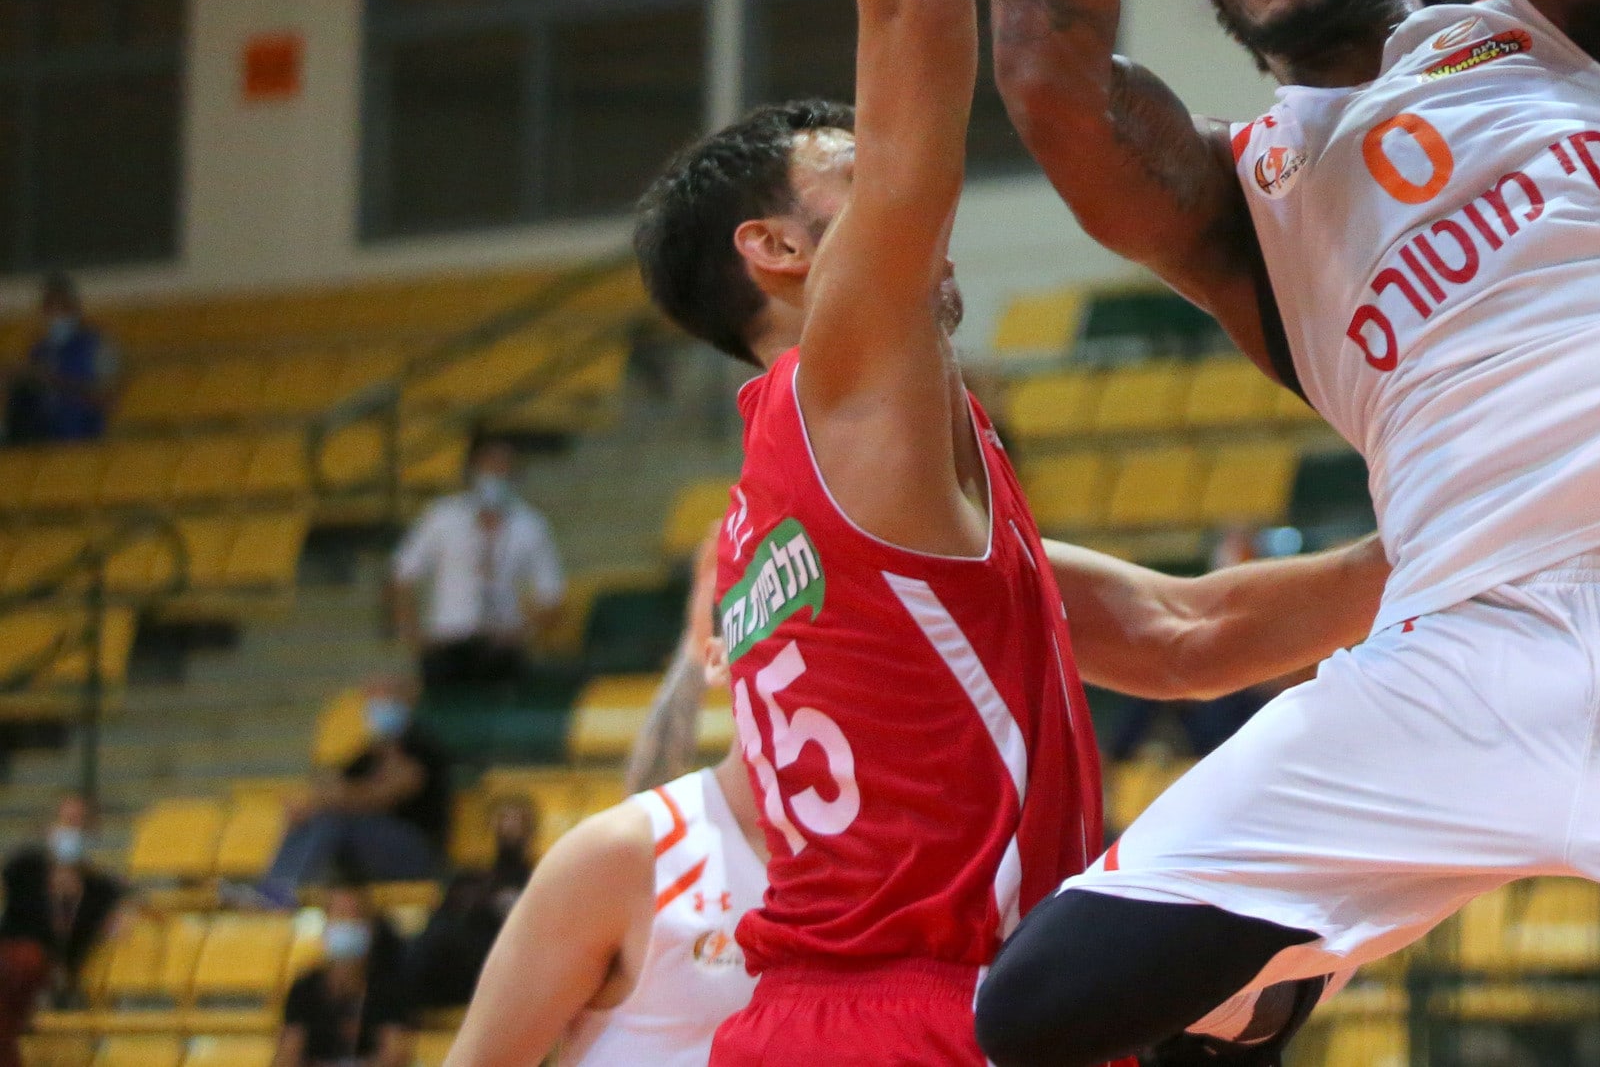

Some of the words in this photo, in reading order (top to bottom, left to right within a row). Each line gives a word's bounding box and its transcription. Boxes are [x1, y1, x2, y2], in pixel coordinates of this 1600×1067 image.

[1362, 112, 1454, 204] 0
[1346, 170, 1546, 372] מוטורס
[734, 640, 862, 857] 15
